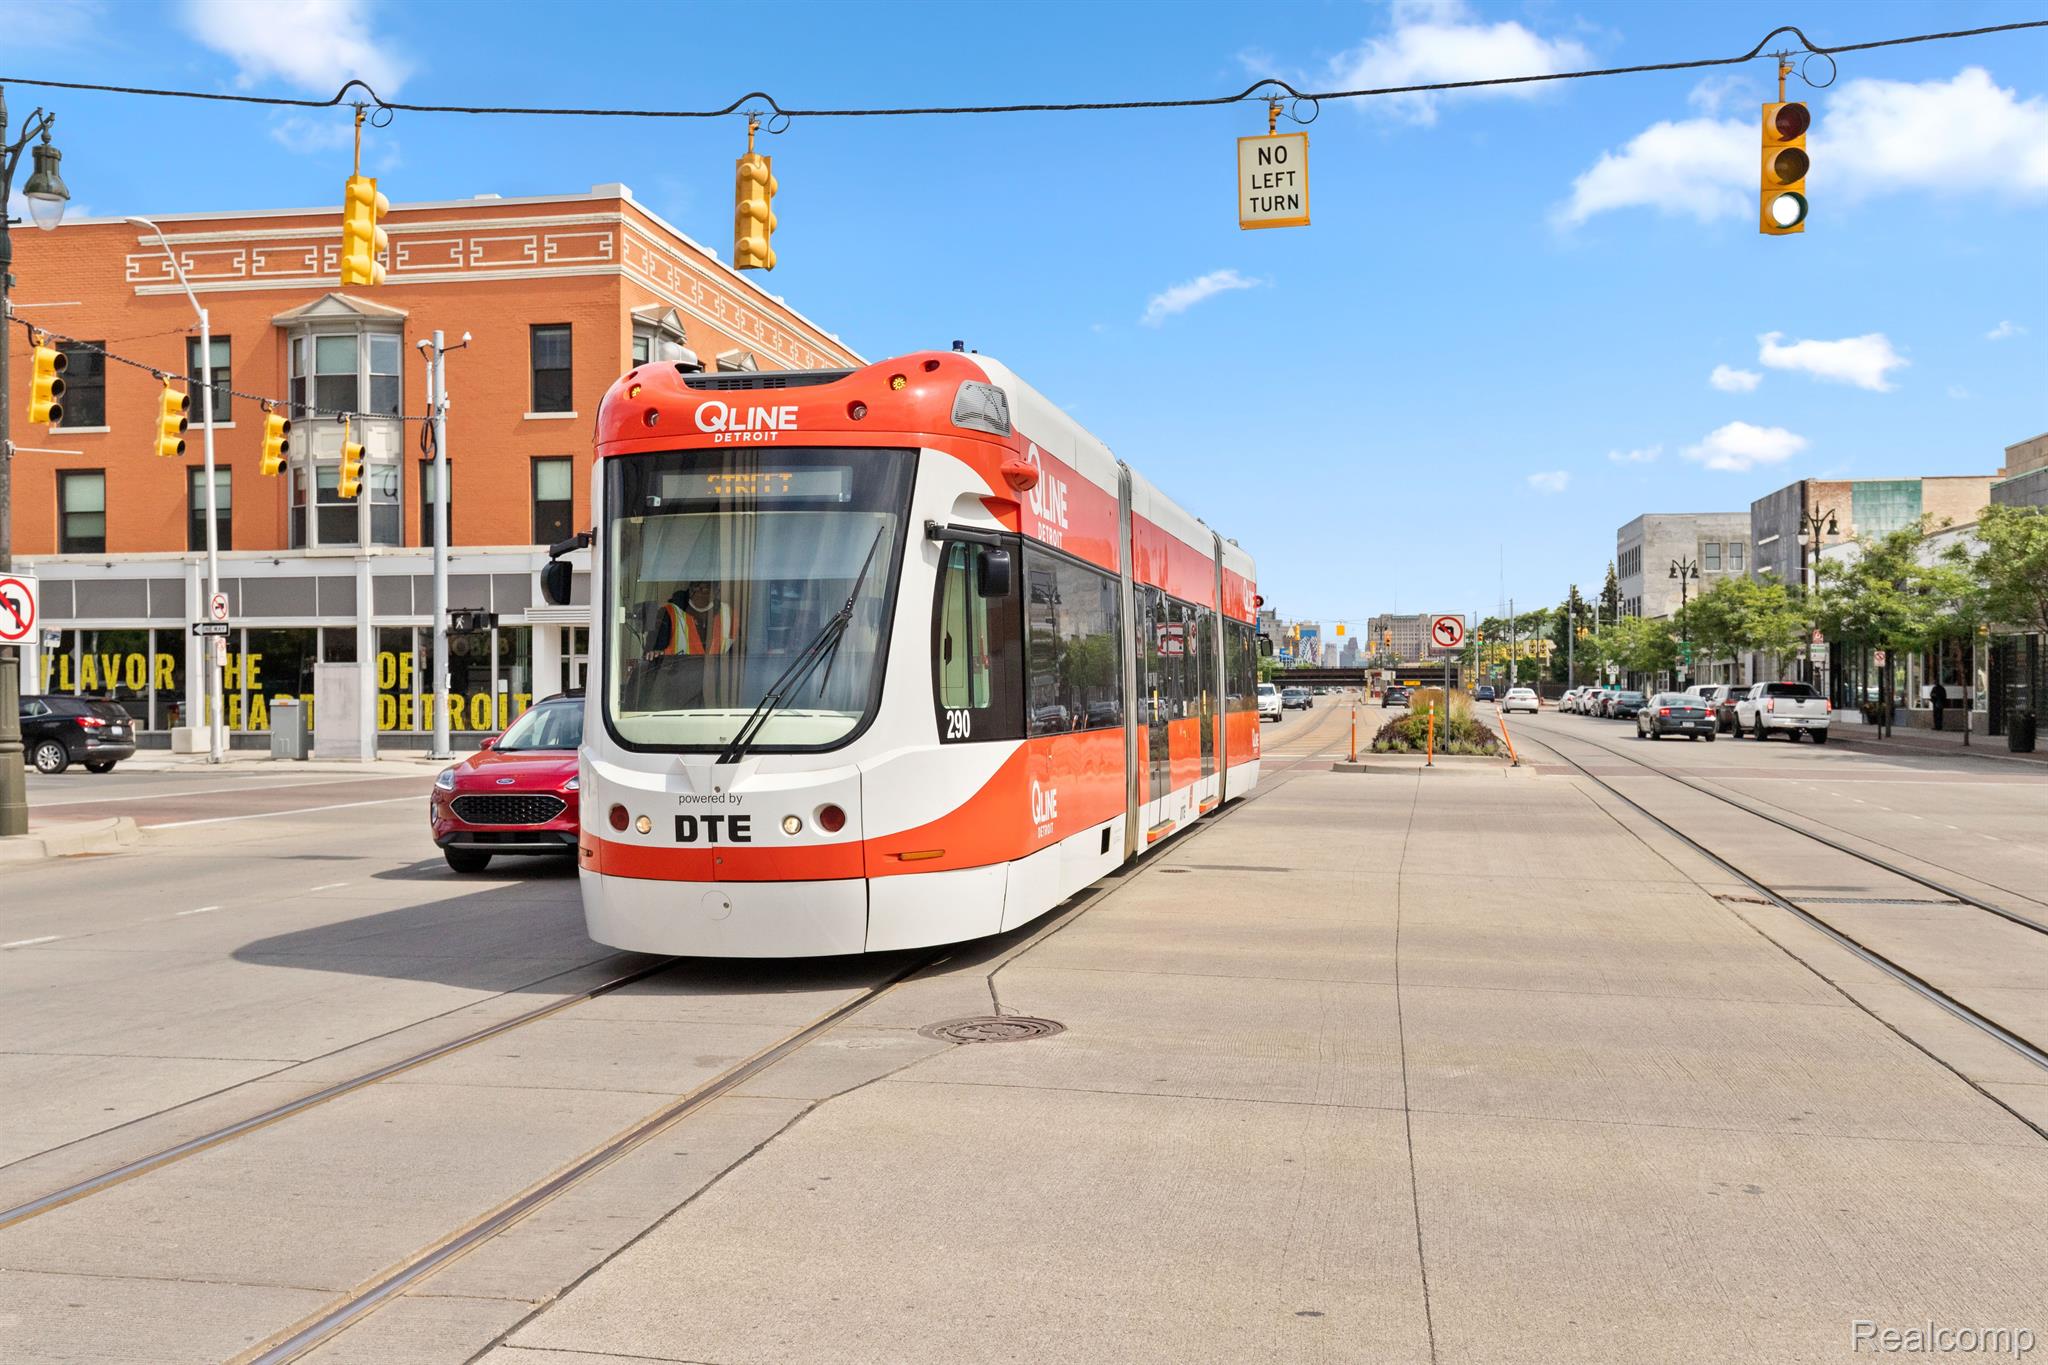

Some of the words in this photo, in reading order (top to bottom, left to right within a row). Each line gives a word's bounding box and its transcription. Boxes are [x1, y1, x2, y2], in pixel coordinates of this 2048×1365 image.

[1258, 145, 1288, 166] NO
[1251, 170, 1296, 190] LEFT
[1249, 193, 1299, 213] TURN
[694, 400, 799, 433] QLINE
[714, 431, 778, 443] DETROIT
[1027, 442, 1069, 530] QLINE
[1037, 520, 1063, 549] DETROIT
[40, 653, 176, 690] FLAVOR
[204, 653, 262, 690] HE
[377, 651, 414, 690] OF
[377, 692, 532, 731] DETROIT
[946, 709, 971, 739] 290
[678, 792, 725, 805] powered
[728, 792, 743, 806] by
[1031, 779, 1057, 825] QLINE
[674, 814, 752, 843] DTE
